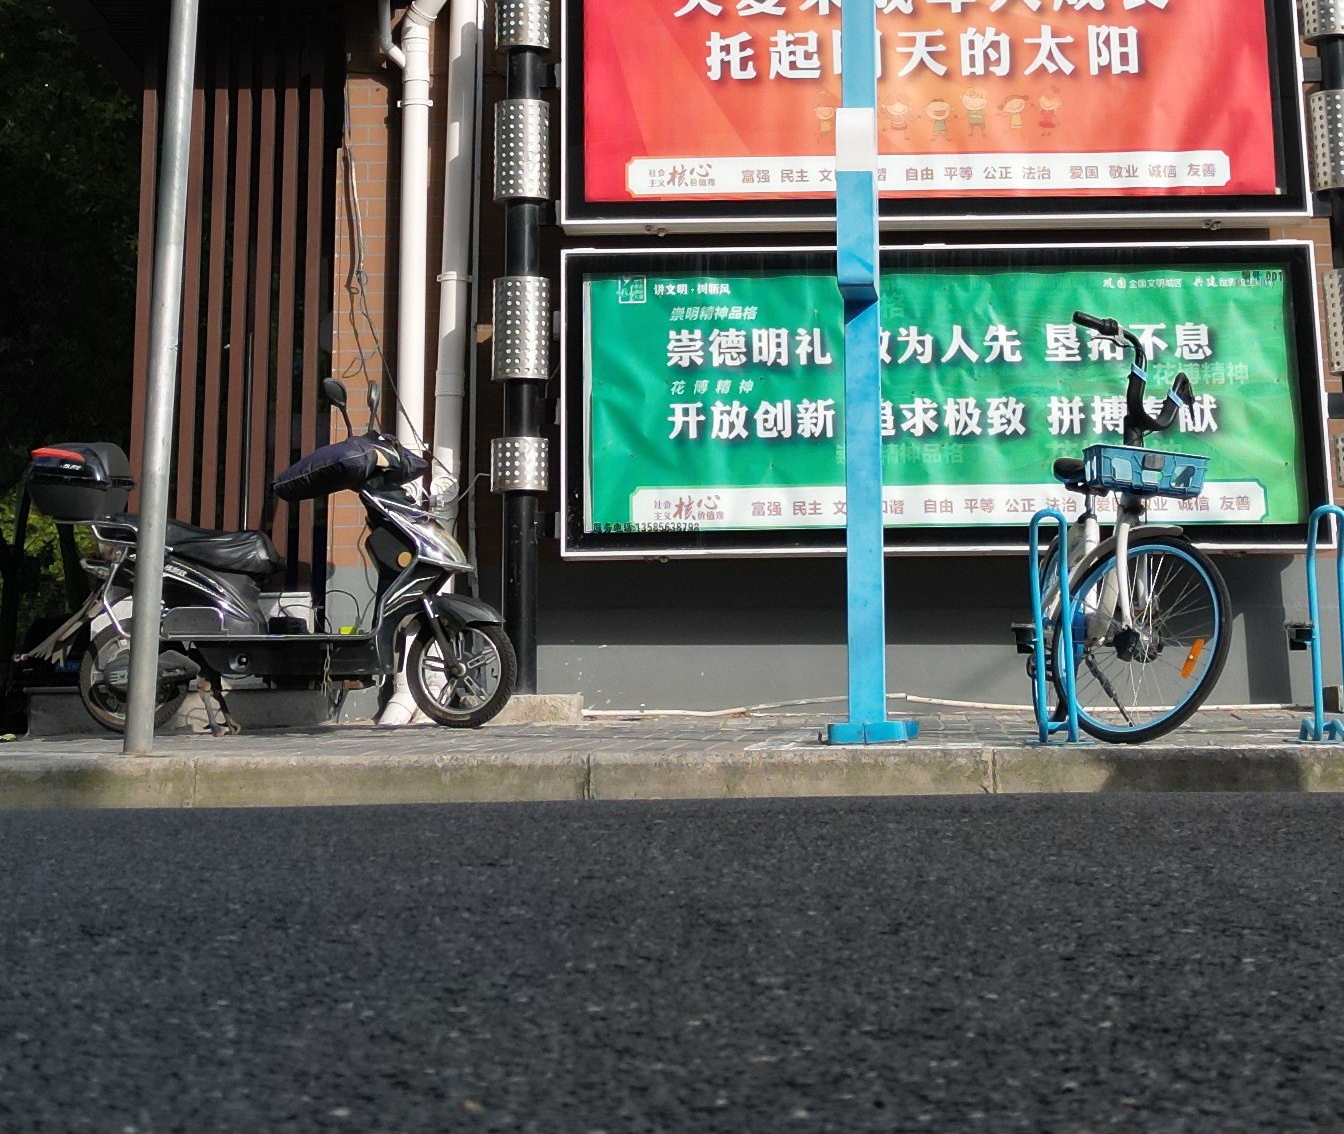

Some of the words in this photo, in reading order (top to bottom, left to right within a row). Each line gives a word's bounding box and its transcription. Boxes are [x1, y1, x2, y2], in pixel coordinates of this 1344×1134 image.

[706, 24, 1140, 82] 托起天的太阳
[780, 168, 810, 183] 民主
[906, 167, 934, 181] 自由
[944, 166, 973, 181] 平等
[983, 166, 1012, 180] 公正
[1022, 166, 1052, 180] 法治
[1070, 165, 1099, 180] 爱国
[1108, 165, 1140, 179] 敬业
[1148, 164, 1178, 179] 诚信
[1187, 163, 1217, 178] 友善
[667, 327, 833, 368] 崇德明礼
[670, 379, 755, 395] 花博精神
[667, 398, 836, 440] 开放创新
[751, 500, 783, 517] 富强
[792, 500, 824, 516] 民主
[923, 498, 954, 515] 自由
[964, 498, 996, 515] 平等
[1005, 497, 1037, 514] 公正
[1219, 494, 1252, 511] 友善
